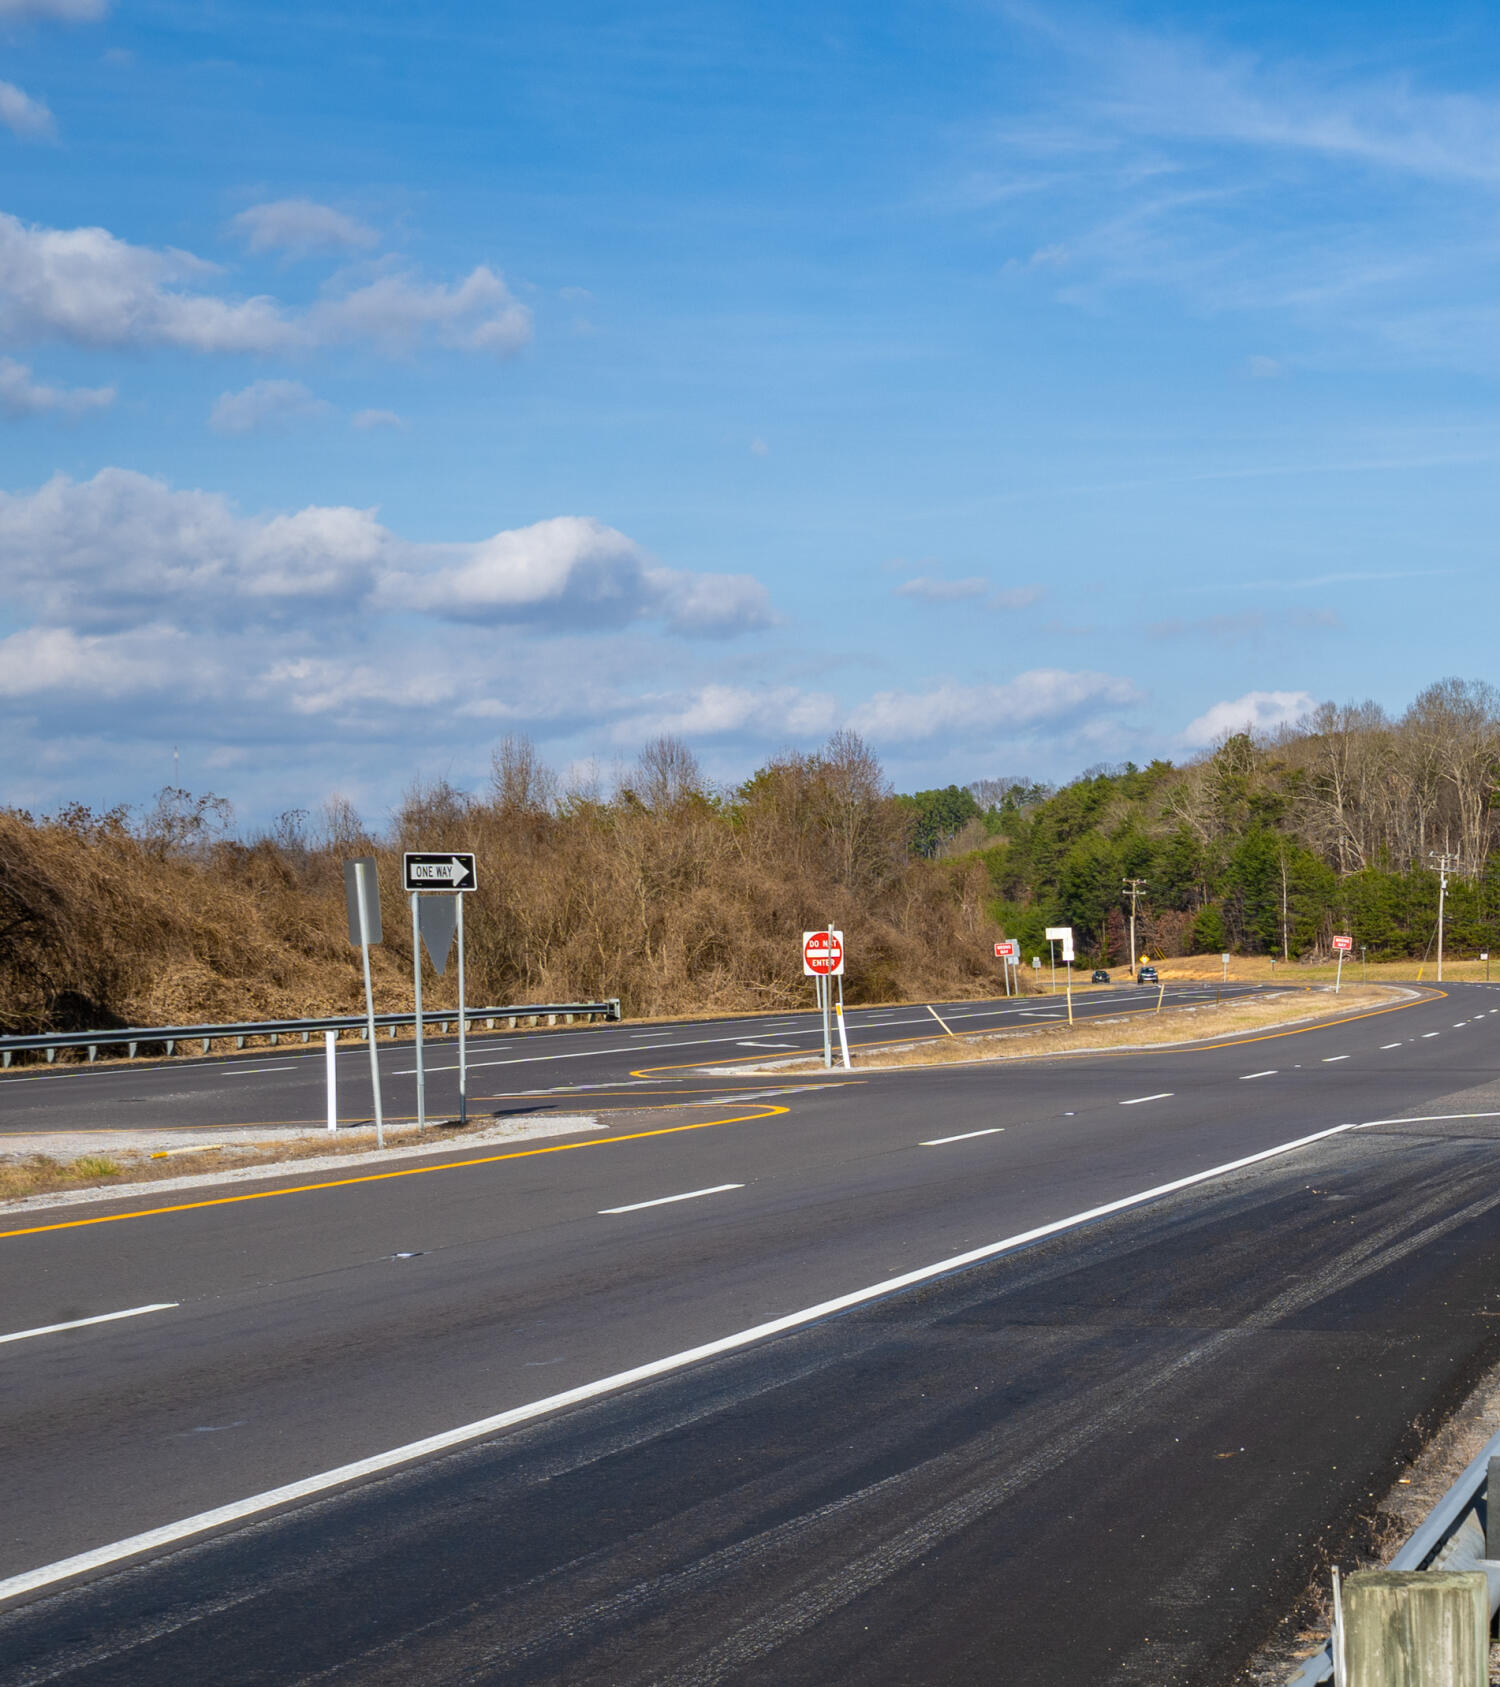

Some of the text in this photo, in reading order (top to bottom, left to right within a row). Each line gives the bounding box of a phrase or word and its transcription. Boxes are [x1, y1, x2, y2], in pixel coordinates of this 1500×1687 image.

[416, 865, 453, 877] ONE WAY
[809, 940, 820, 948] DO
[812, 959, 835, 967] ENTER
